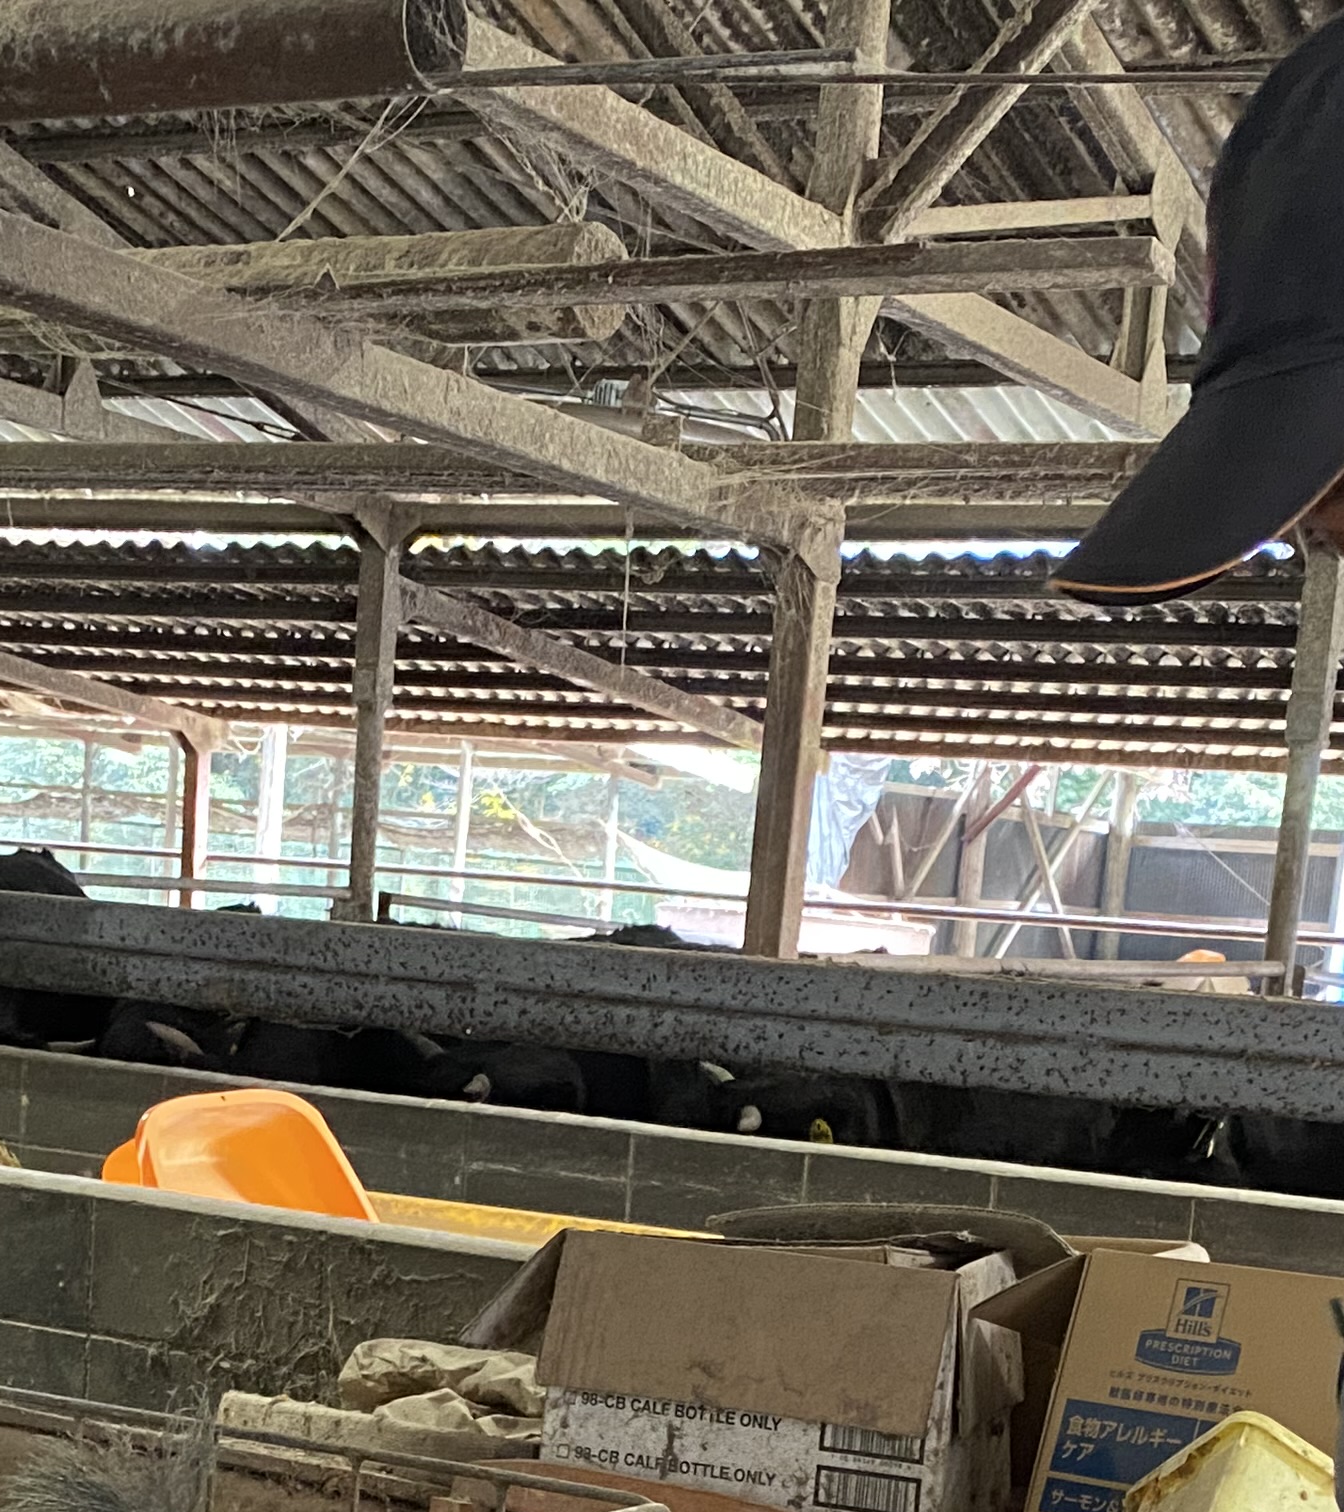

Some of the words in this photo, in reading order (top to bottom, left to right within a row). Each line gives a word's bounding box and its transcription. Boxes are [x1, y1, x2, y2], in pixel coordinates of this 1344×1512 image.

[1172, 1317, 1212, 1338] Hill's
[1144, 1338, 1233, 1361] PRESCRIPTION
[1170, 1353, 1201, 1369] DIET
[581, 1391, 626, 1411] 98-CB
[630, 1398, 672, 1416] CALF
[674, 1403, 736, 1426] BOTTLE
[739, 1413, 782, 1432] ONLY
[1066, 1414, 1182, 1450] 食物アレルギー
[1061, 1440, 1094, 1462] ケア
[574, 1445, 620, 1465] 98-CB
[623, 1452, 665, 1472] CALF
[667, 1456, 732, 1480] BOTTLE
[733, 1467, 776, 1487] ONLY
